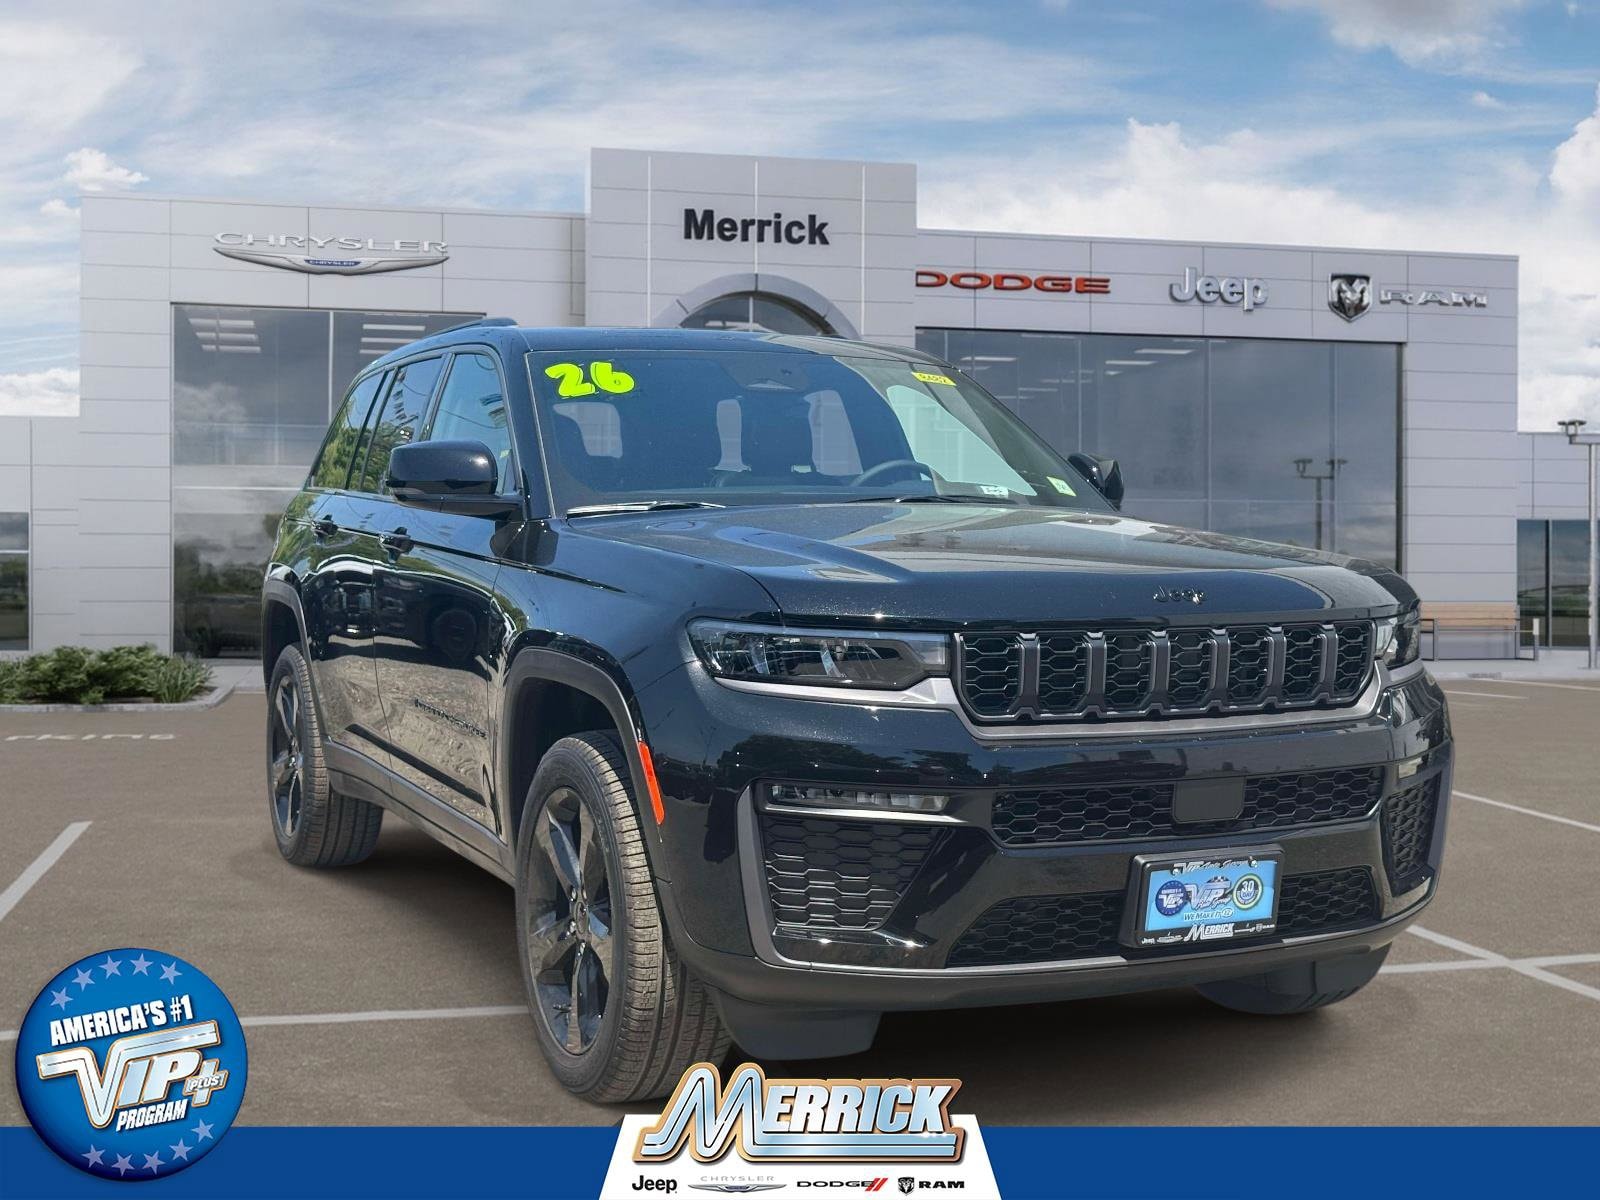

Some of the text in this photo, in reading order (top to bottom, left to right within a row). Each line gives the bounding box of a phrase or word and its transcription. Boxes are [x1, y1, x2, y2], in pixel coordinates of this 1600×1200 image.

[684, 208, 830, 245] Merrick
[214, 232, 450, 253] CHRYSLER
[915, 271, 1111, 294] DODGE
[1170, 267, 1269, 312] Jeep
[1380, 289, 1488, 307] RAM
[544, 362, 635, 397] 26
[1241, 880, 1255, 892] 30
[1184, 922, 1235, 941] MERRICK
